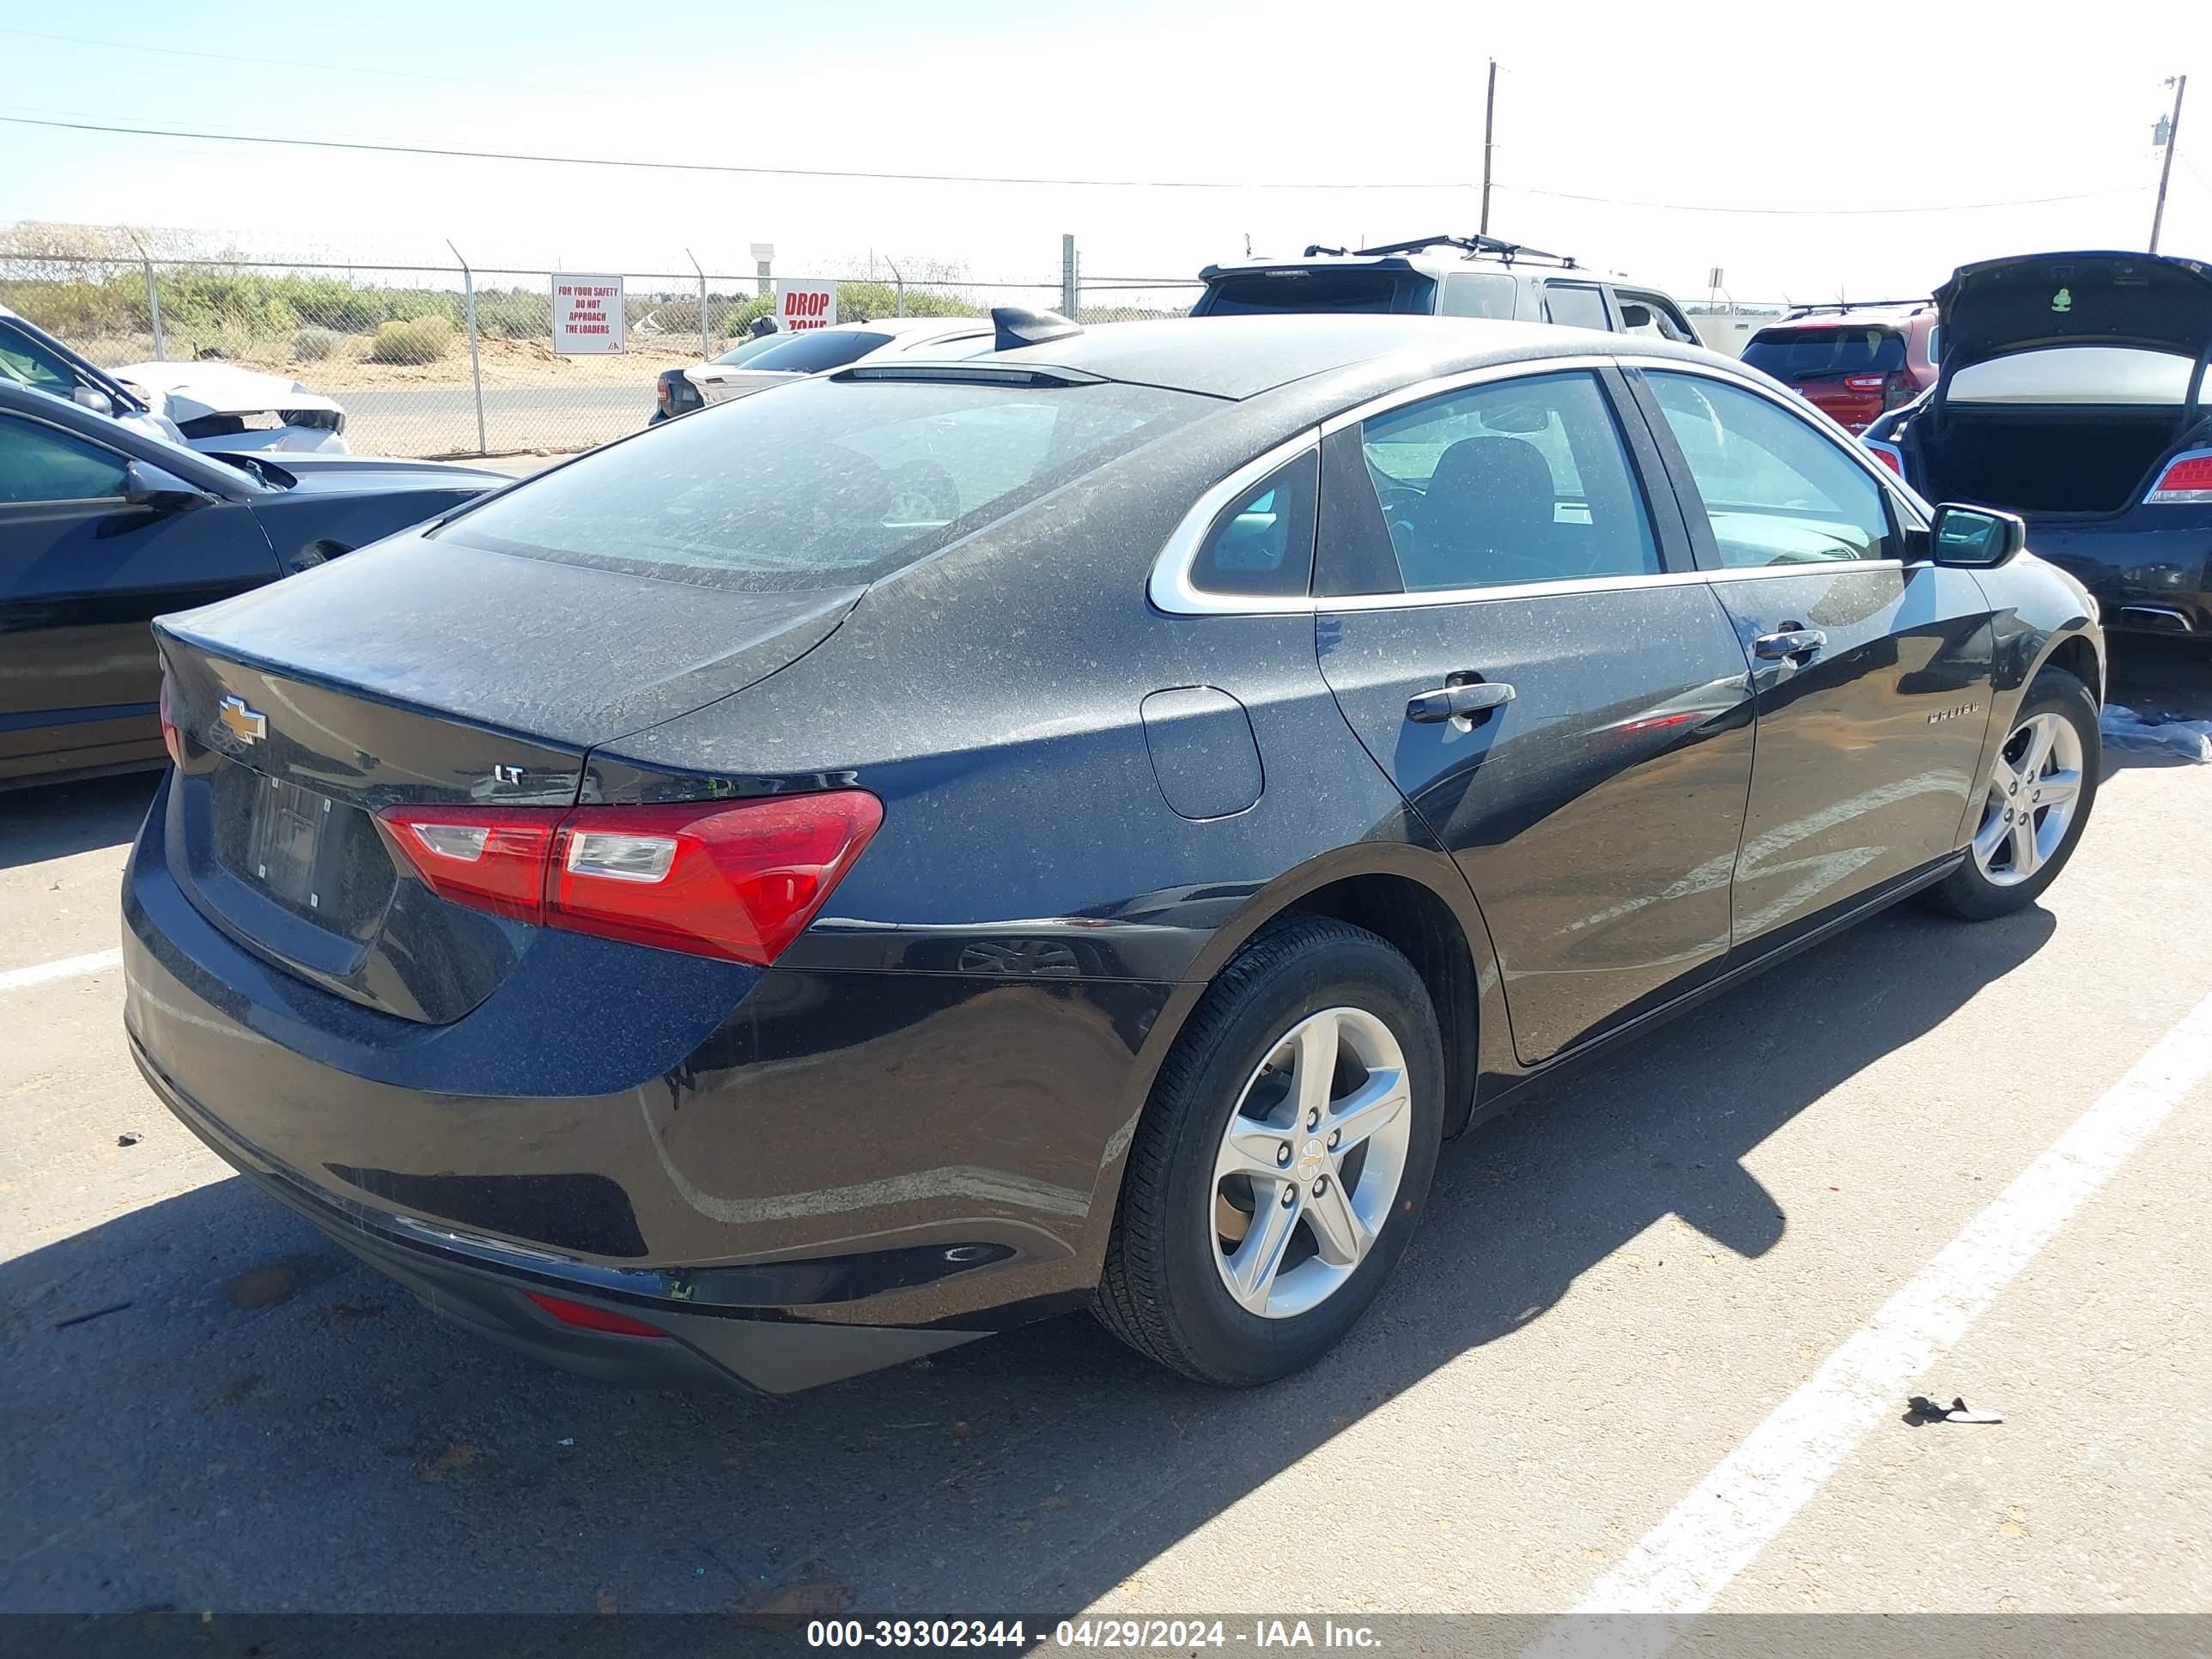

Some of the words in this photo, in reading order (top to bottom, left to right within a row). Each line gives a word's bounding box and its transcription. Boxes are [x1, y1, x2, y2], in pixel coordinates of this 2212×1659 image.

[558, 286, 572, 296] FOR
[574, 287, 592, 296] YOUR
[593, 287, 618, 297] SAFETY
[575, 299, 586, 309] DO
[586, 300, 601, 309] NOT
[785, 292, 830, 316] DROP
[568, 312, 606, 322] APPROACH
[565, 325, 579, 334] THE
[579, 325, 610, 334] LOADERS
[1927, 701, 1979, 725] MALIBU
[495, 763, 523, 786] LT
